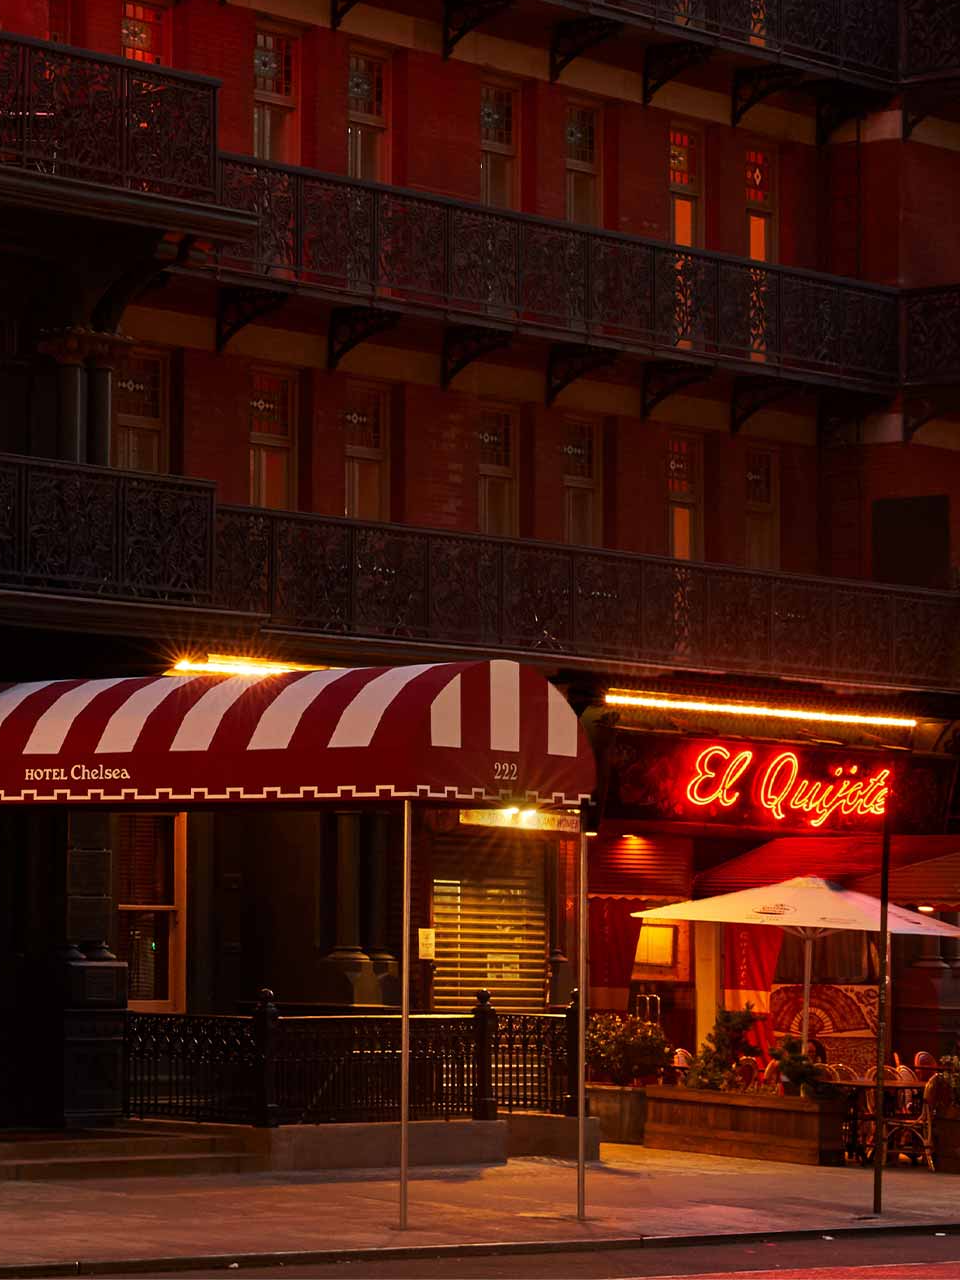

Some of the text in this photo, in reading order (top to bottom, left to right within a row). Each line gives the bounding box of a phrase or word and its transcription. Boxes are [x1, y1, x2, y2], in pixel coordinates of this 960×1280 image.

[24, 764, 131, 781] HOTEL Chelsea
[494, 762, 518, 780] 222
[686, 745, 890, 827] El Quijote
